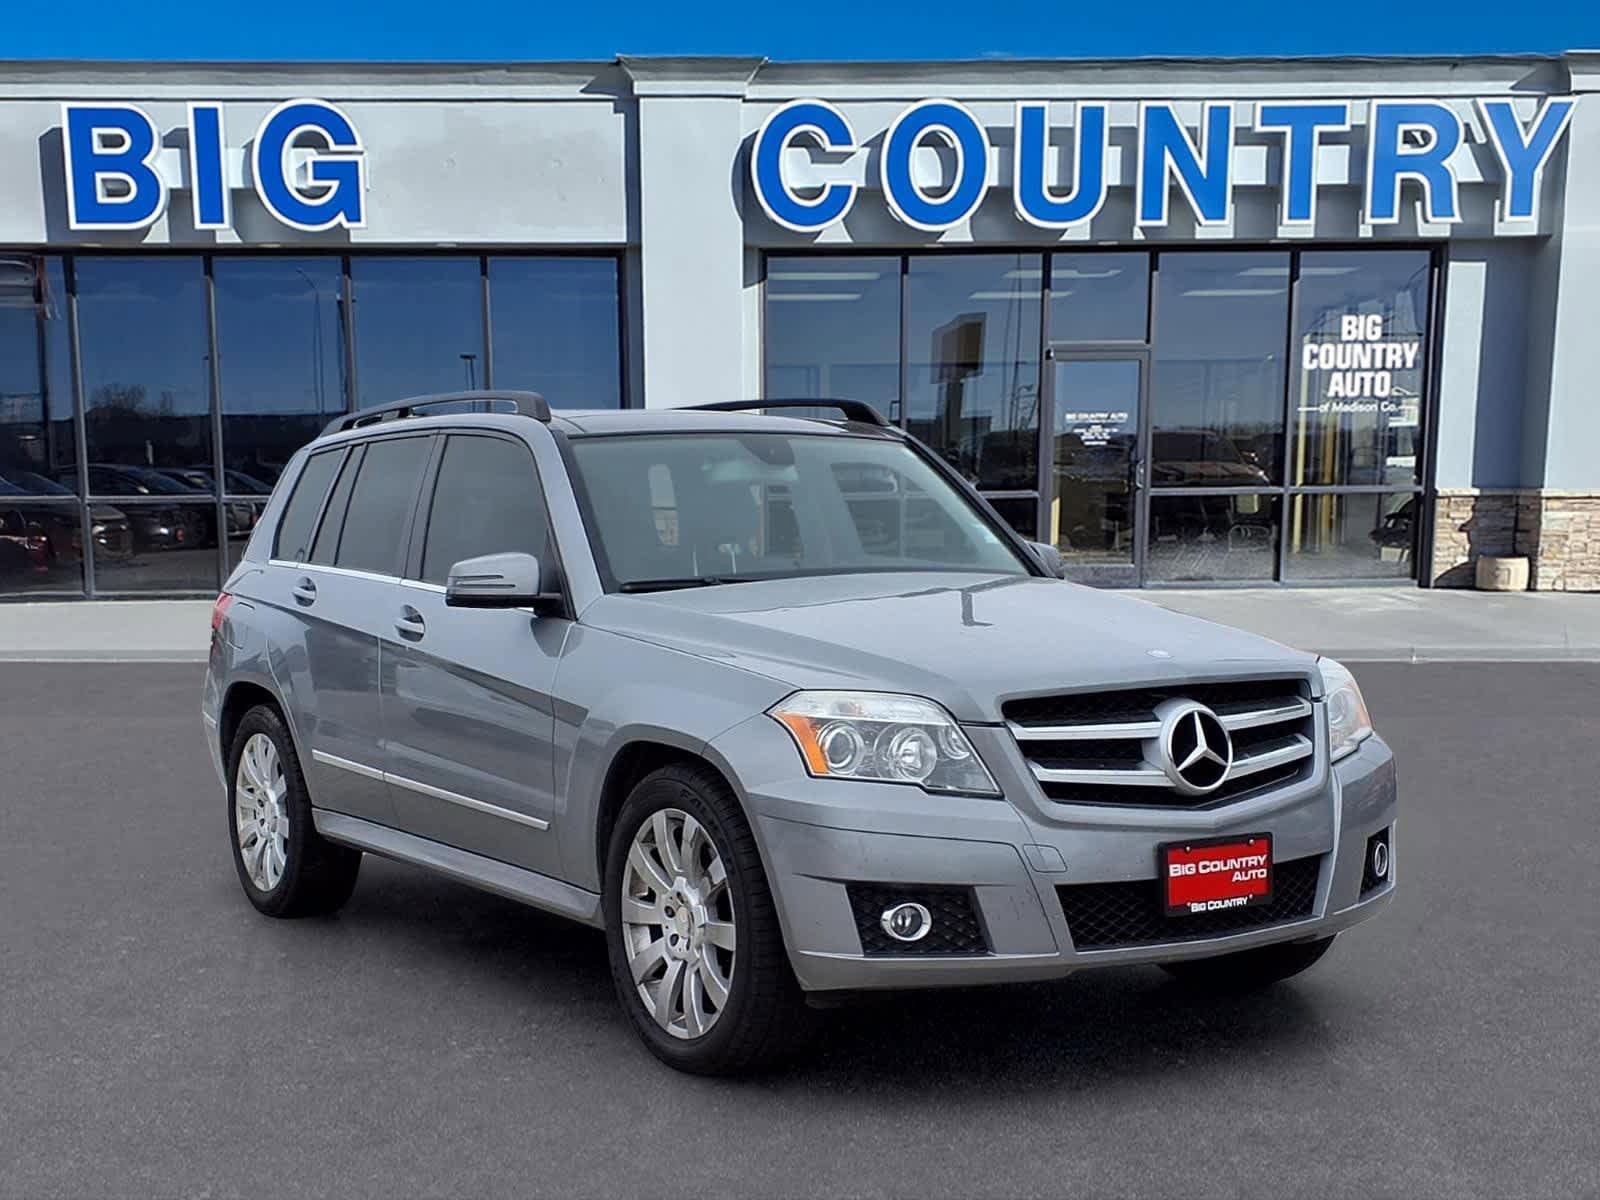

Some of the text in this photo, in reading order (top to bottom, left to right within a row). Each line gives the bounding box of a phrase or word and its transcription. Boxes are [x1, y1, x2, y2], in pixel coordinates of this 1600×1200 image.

[61, 97, 1576, 233] BIG COUNTRY
[1341, 314, 1383, 341] BIG
[1302, 343, 1418, 369] COUNTRY
[1327, 370, 1391, 398] AUTO
[1319, 401, 1330, 413] of
[1331, 401, 1378, 412] Madison
[1169, 855, 1267, 877] BIG COUNTRY
[1232, 869, 1267, 882] AUTO
